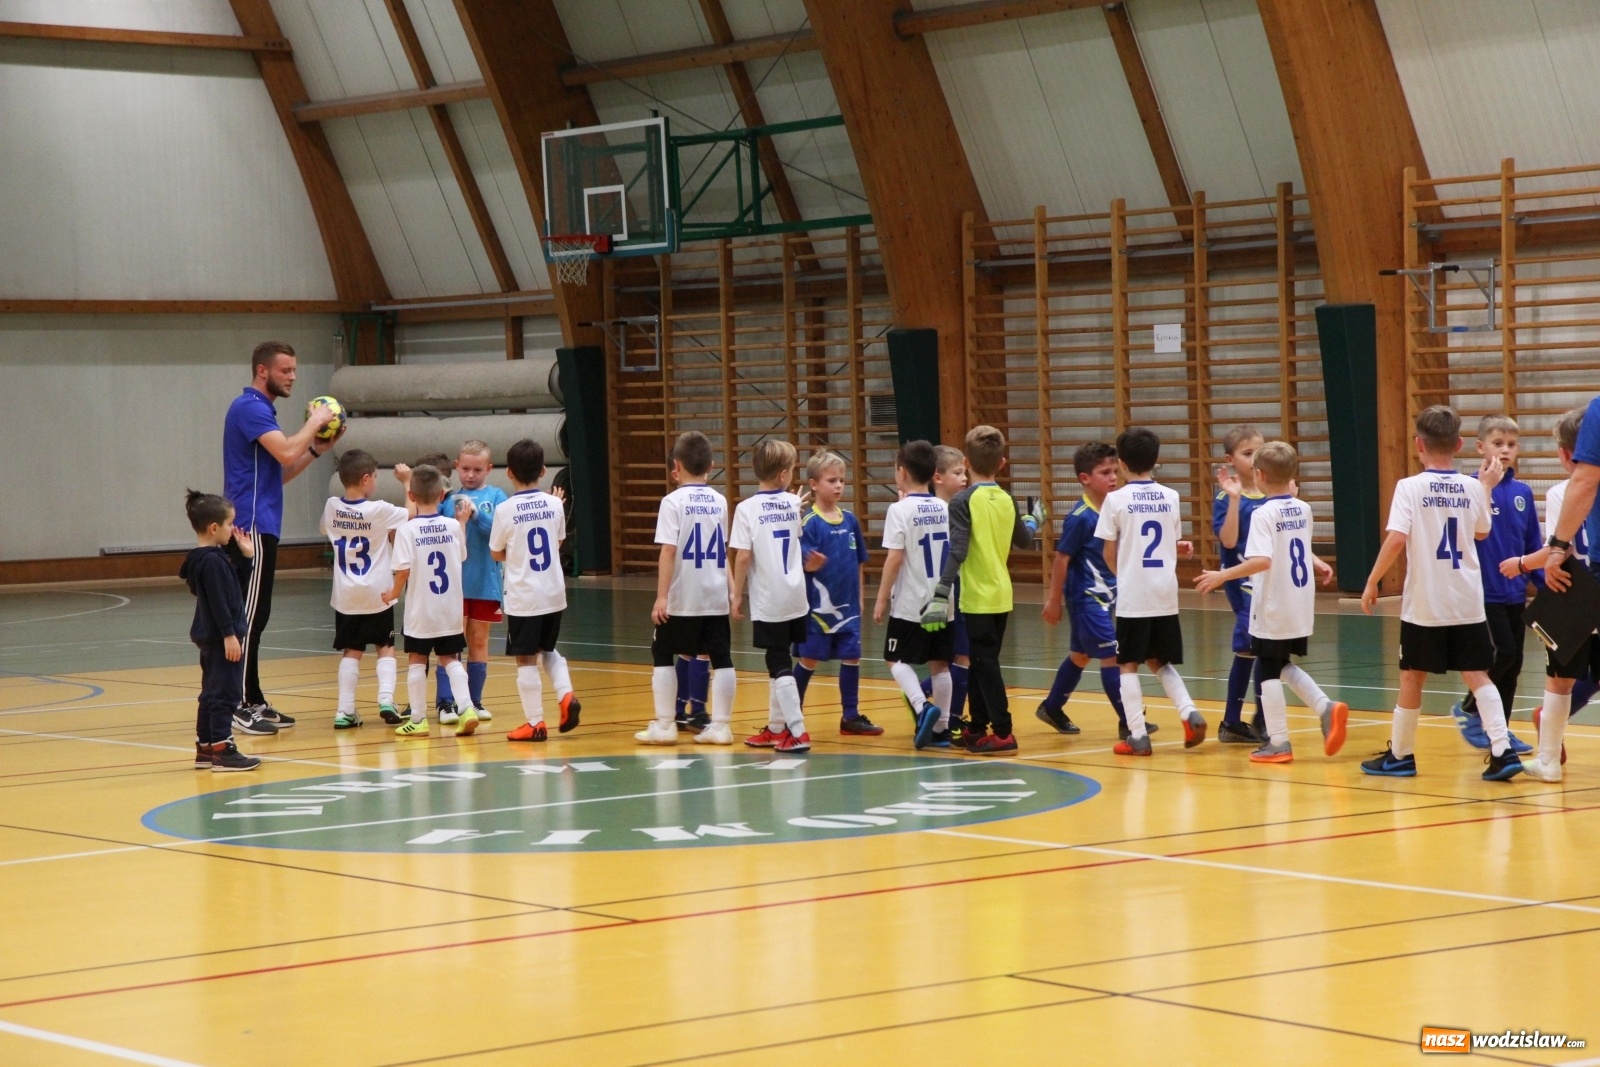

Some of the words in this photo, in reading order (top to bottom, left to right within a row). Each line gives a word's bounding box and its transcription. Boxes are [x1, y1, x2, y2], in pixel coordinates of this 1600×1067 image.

[516, 500, 549, 511] FORTECA
[688, 493, 716, 503] FORTECA
[761, 500, 792, 511] FORTECA
[1132, 491, 1165, 501] FORTECA
[1429, 481, 1465, 494] FORTECA
[335, 509, 364, 521] FORTECA
[419, 523, 448, 535] FORTECA
[334, 535, 372, 576] 13
[527, 526, 551, 572] 9
[682, 522, 726, 569] 44
[773, 529, 791, 575] 7
[918, 531, 950, 578] 17
[1141, 520, 1164, 568] 2
[1289, 537, 1308, 588] 8
[1436, 516, 1463, 570] 4
[427, 550, 450, 595] 3
[888, 637, 898, 652] 17
